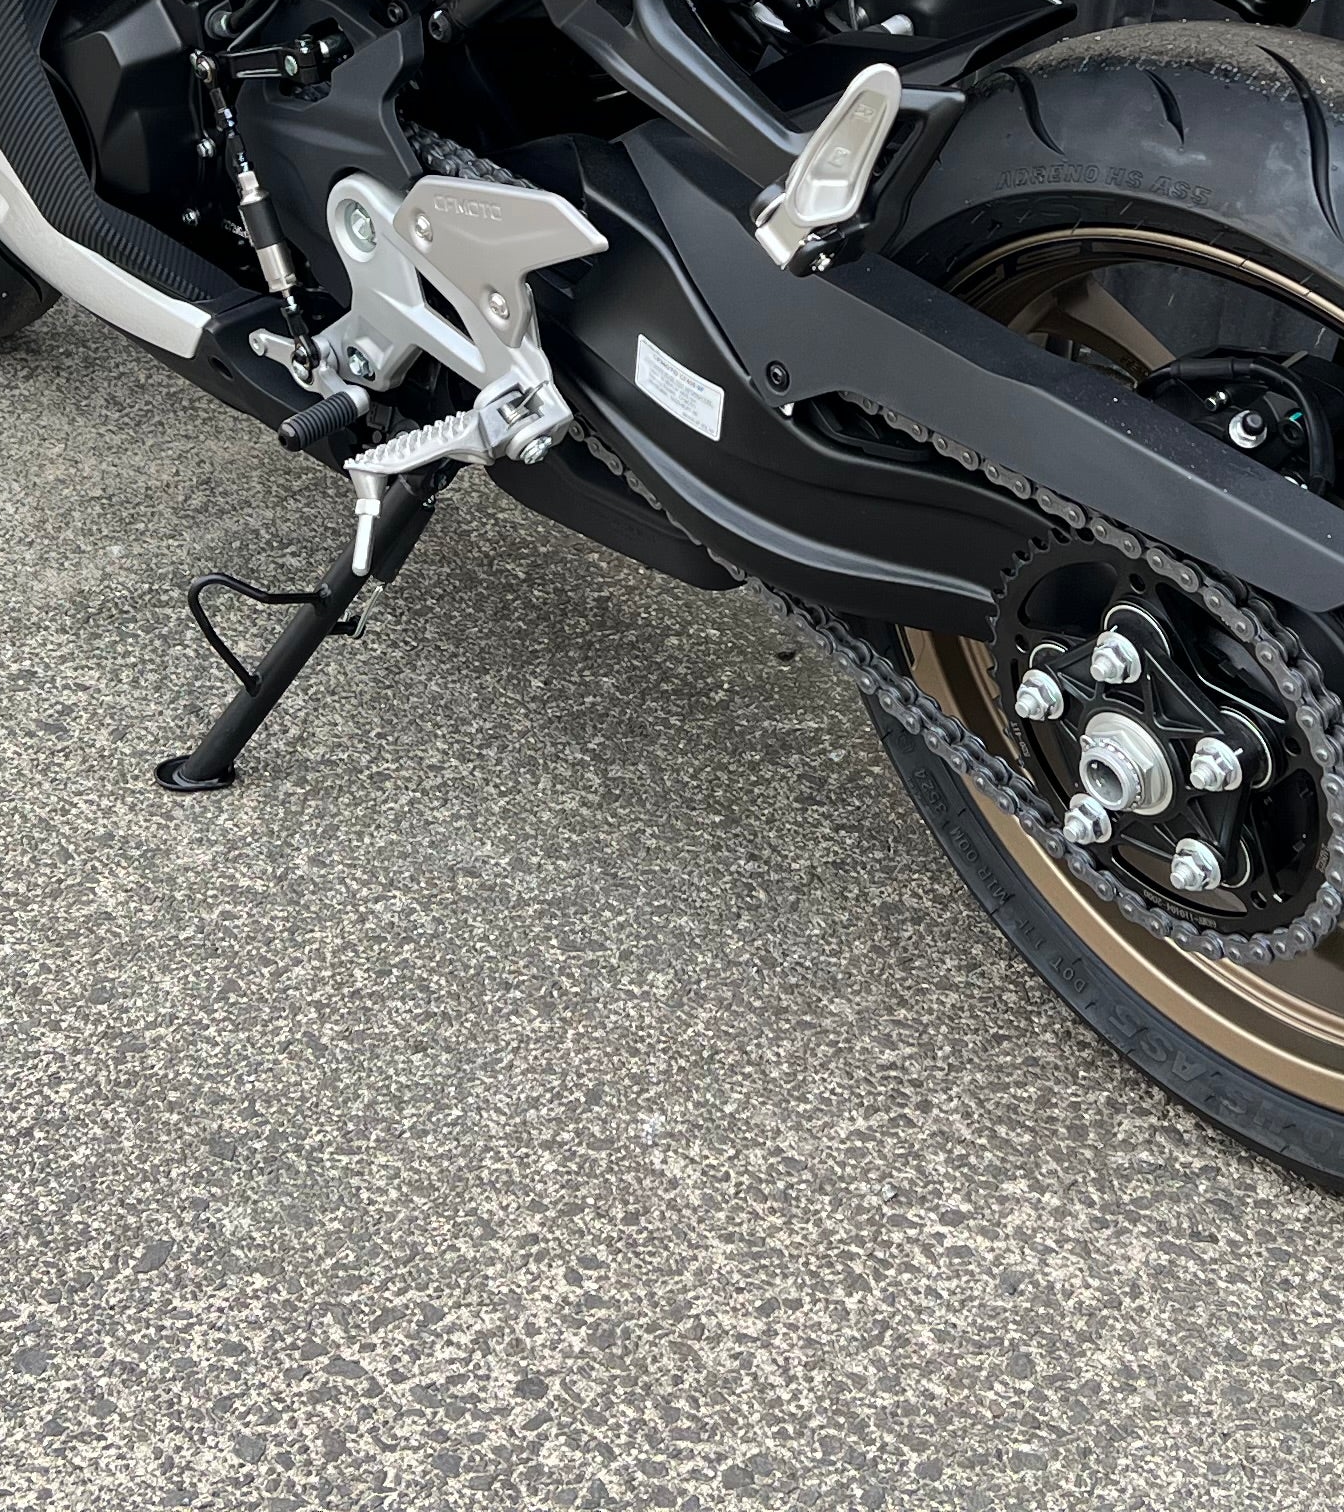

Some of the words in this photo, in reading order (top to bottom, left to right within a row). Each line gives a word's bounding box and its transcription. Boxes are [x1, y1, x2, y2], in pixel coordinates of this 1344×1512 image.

[433, 194, 503, 222] CFMOTO
[995, 163, 1099, 190] ADRENO
[1105, 166, 1145, 189] HS
[1149, 175, 1212, 209] AS5
[913, 768, 949, 813] 3524
[1049, 957, 1086, 993] DOT
[1107, 1002, 1209, 1084] AS5
